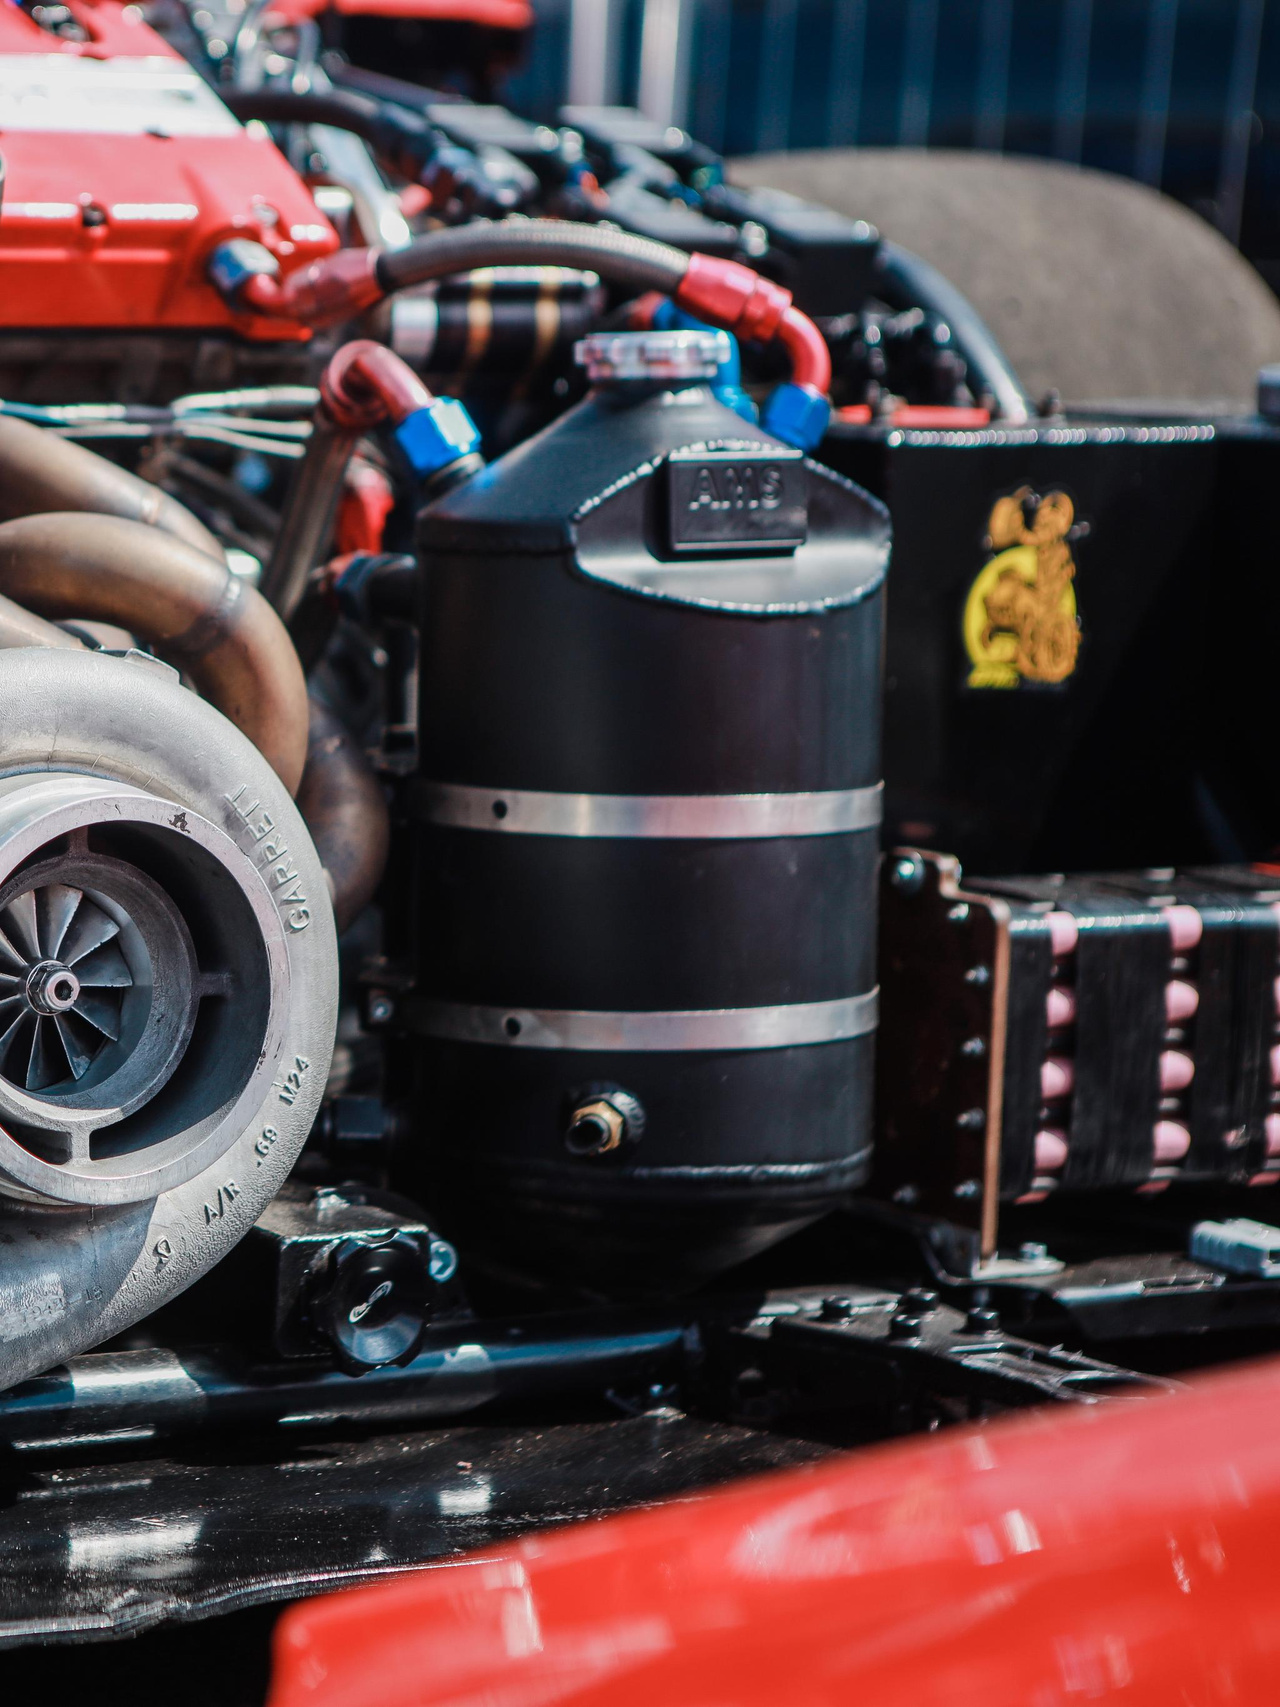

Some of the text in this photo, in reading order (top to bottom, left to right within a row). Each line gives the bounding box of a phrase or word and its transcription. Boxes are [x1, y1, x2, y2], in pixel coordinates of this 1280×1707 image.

[688, 467, 782, 511] AMS
[224, 784, 310, 933] GARRETT
[204, 1179, 240, 1225] A/R
[279, 1055, 309, 1106] M24
